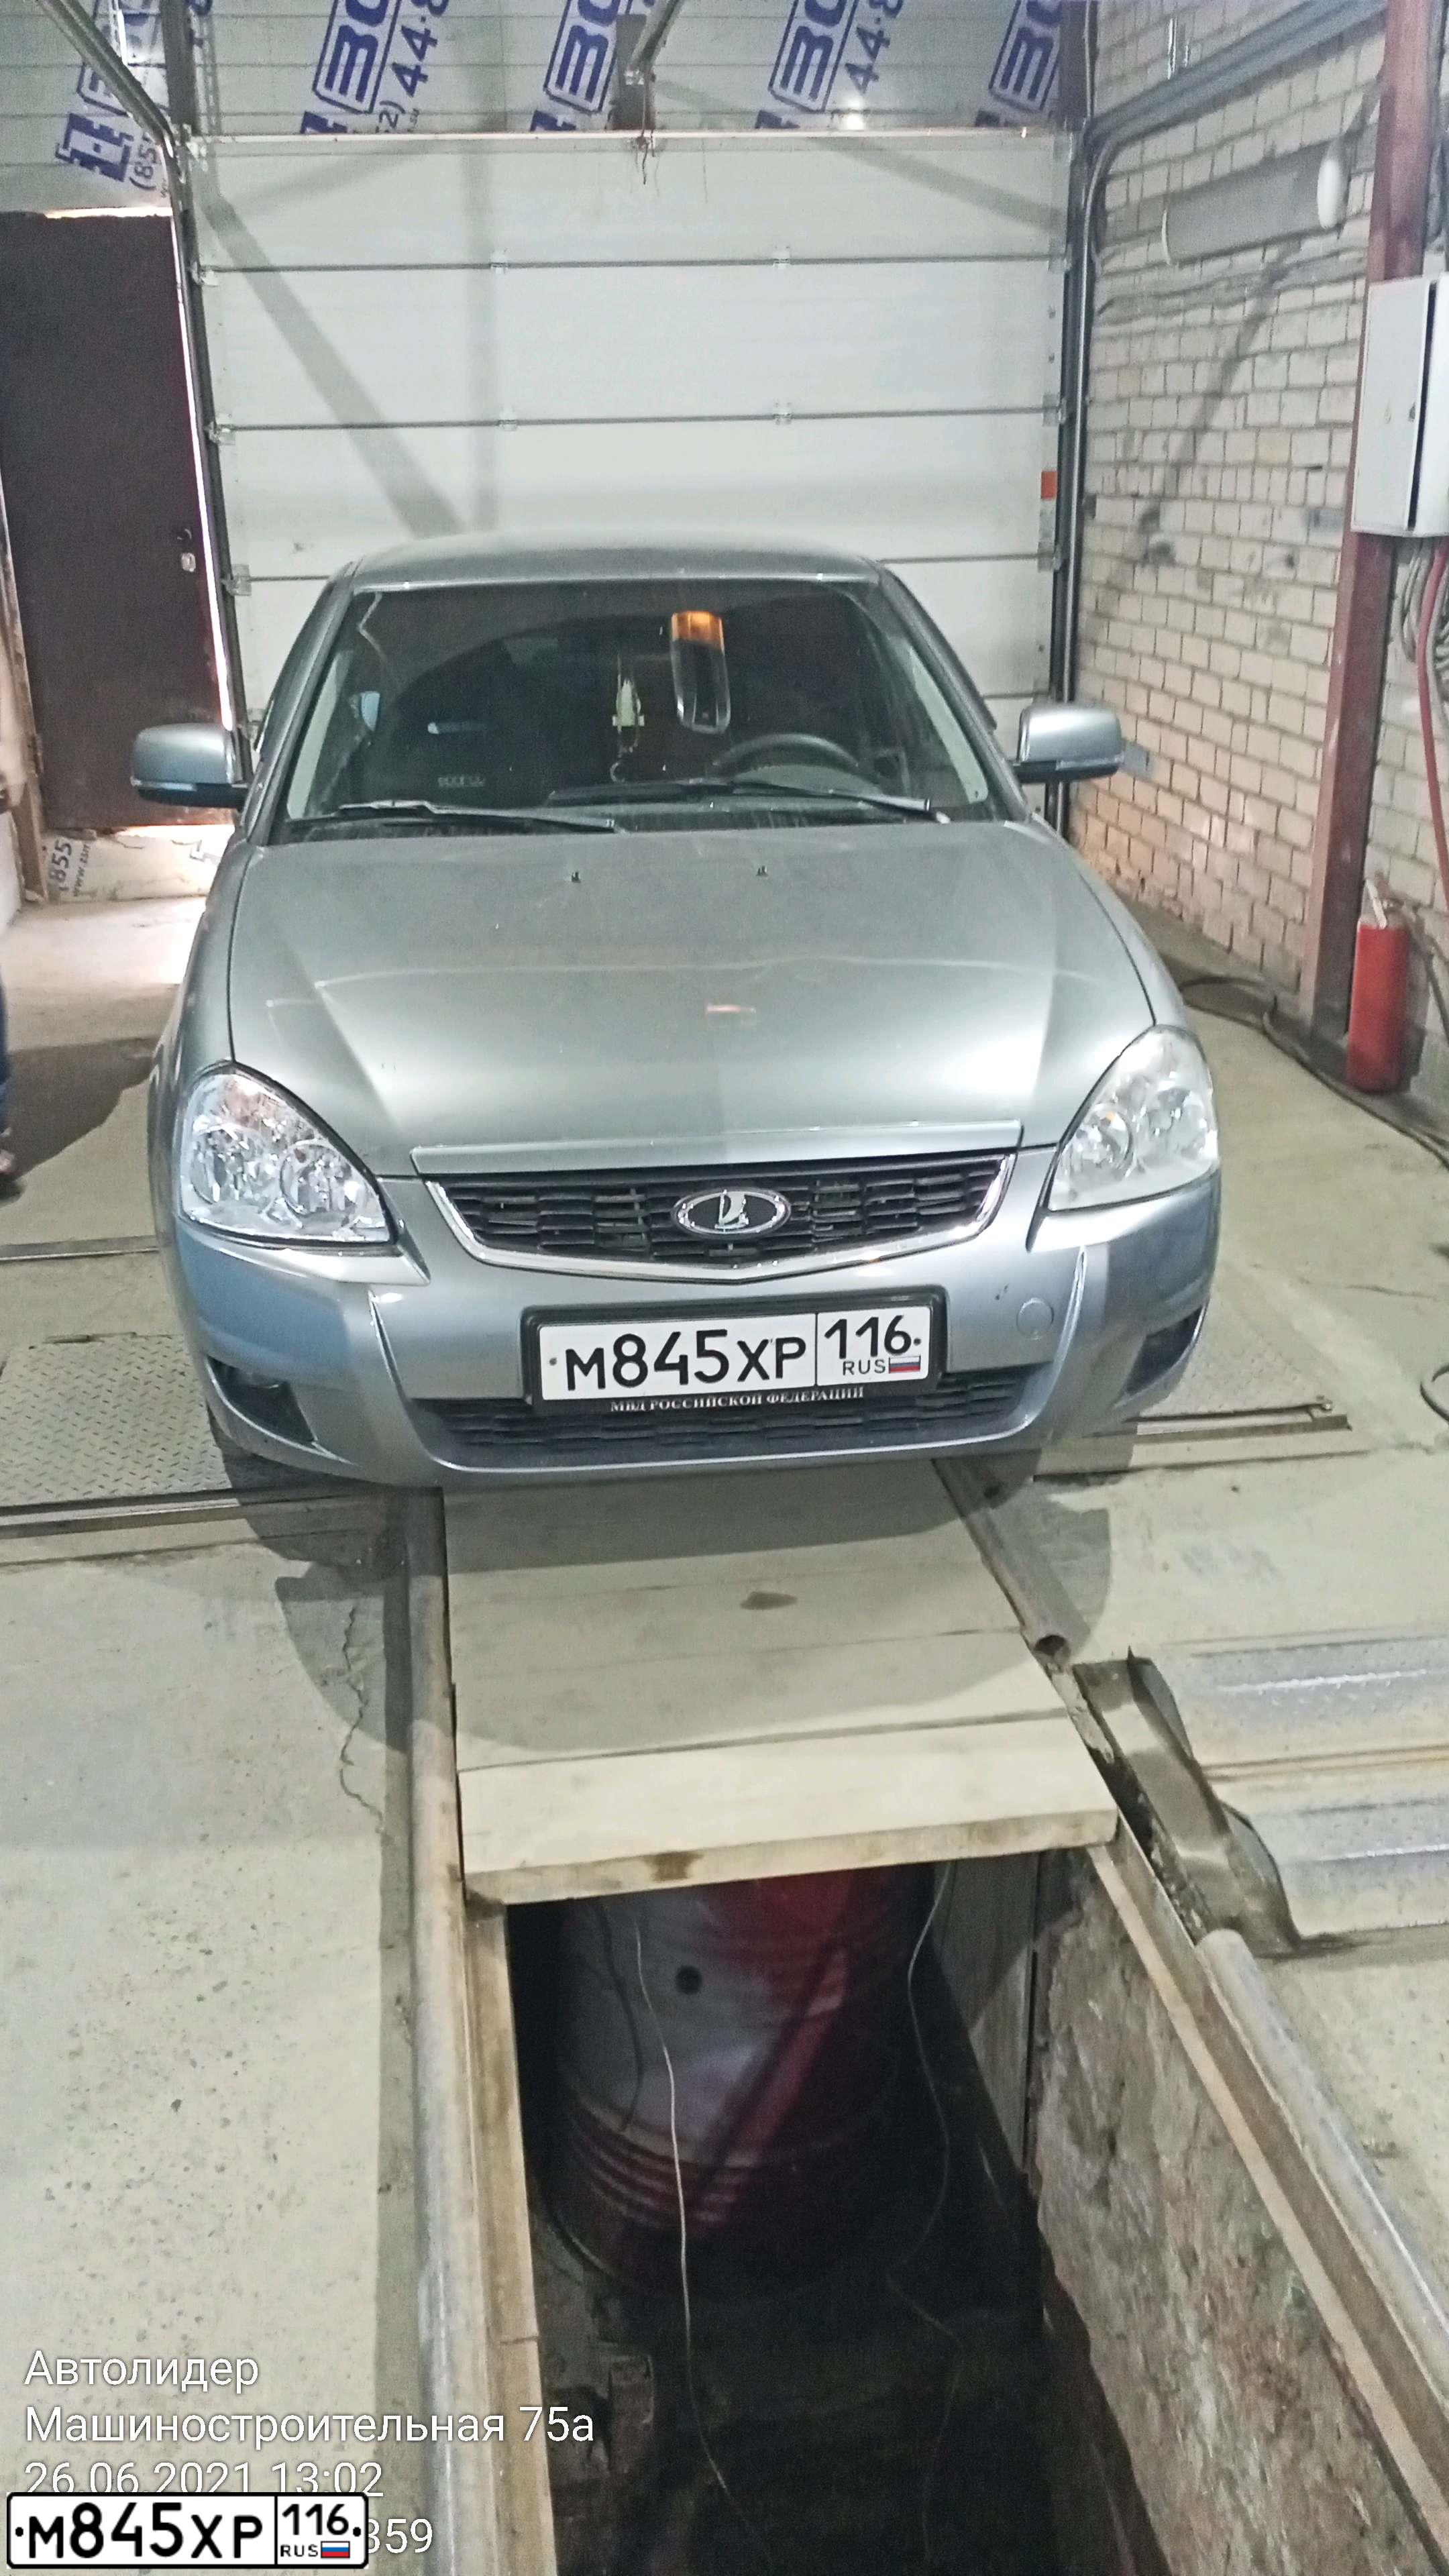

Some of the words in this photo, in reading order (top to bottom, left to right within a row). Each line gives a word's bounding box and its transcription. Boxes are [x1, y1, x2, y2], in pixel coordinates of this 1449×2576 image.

[824, 1314, 912, 1360] 116
[842, 1358, 886, 1376] RUS
[610, 1401, 647, 1413] МВД
[649, 1394, 763, 1410] РОССИЙСКОЙ
[766, 1386, 865, 1405] ФЕДЕРАЦИИ
